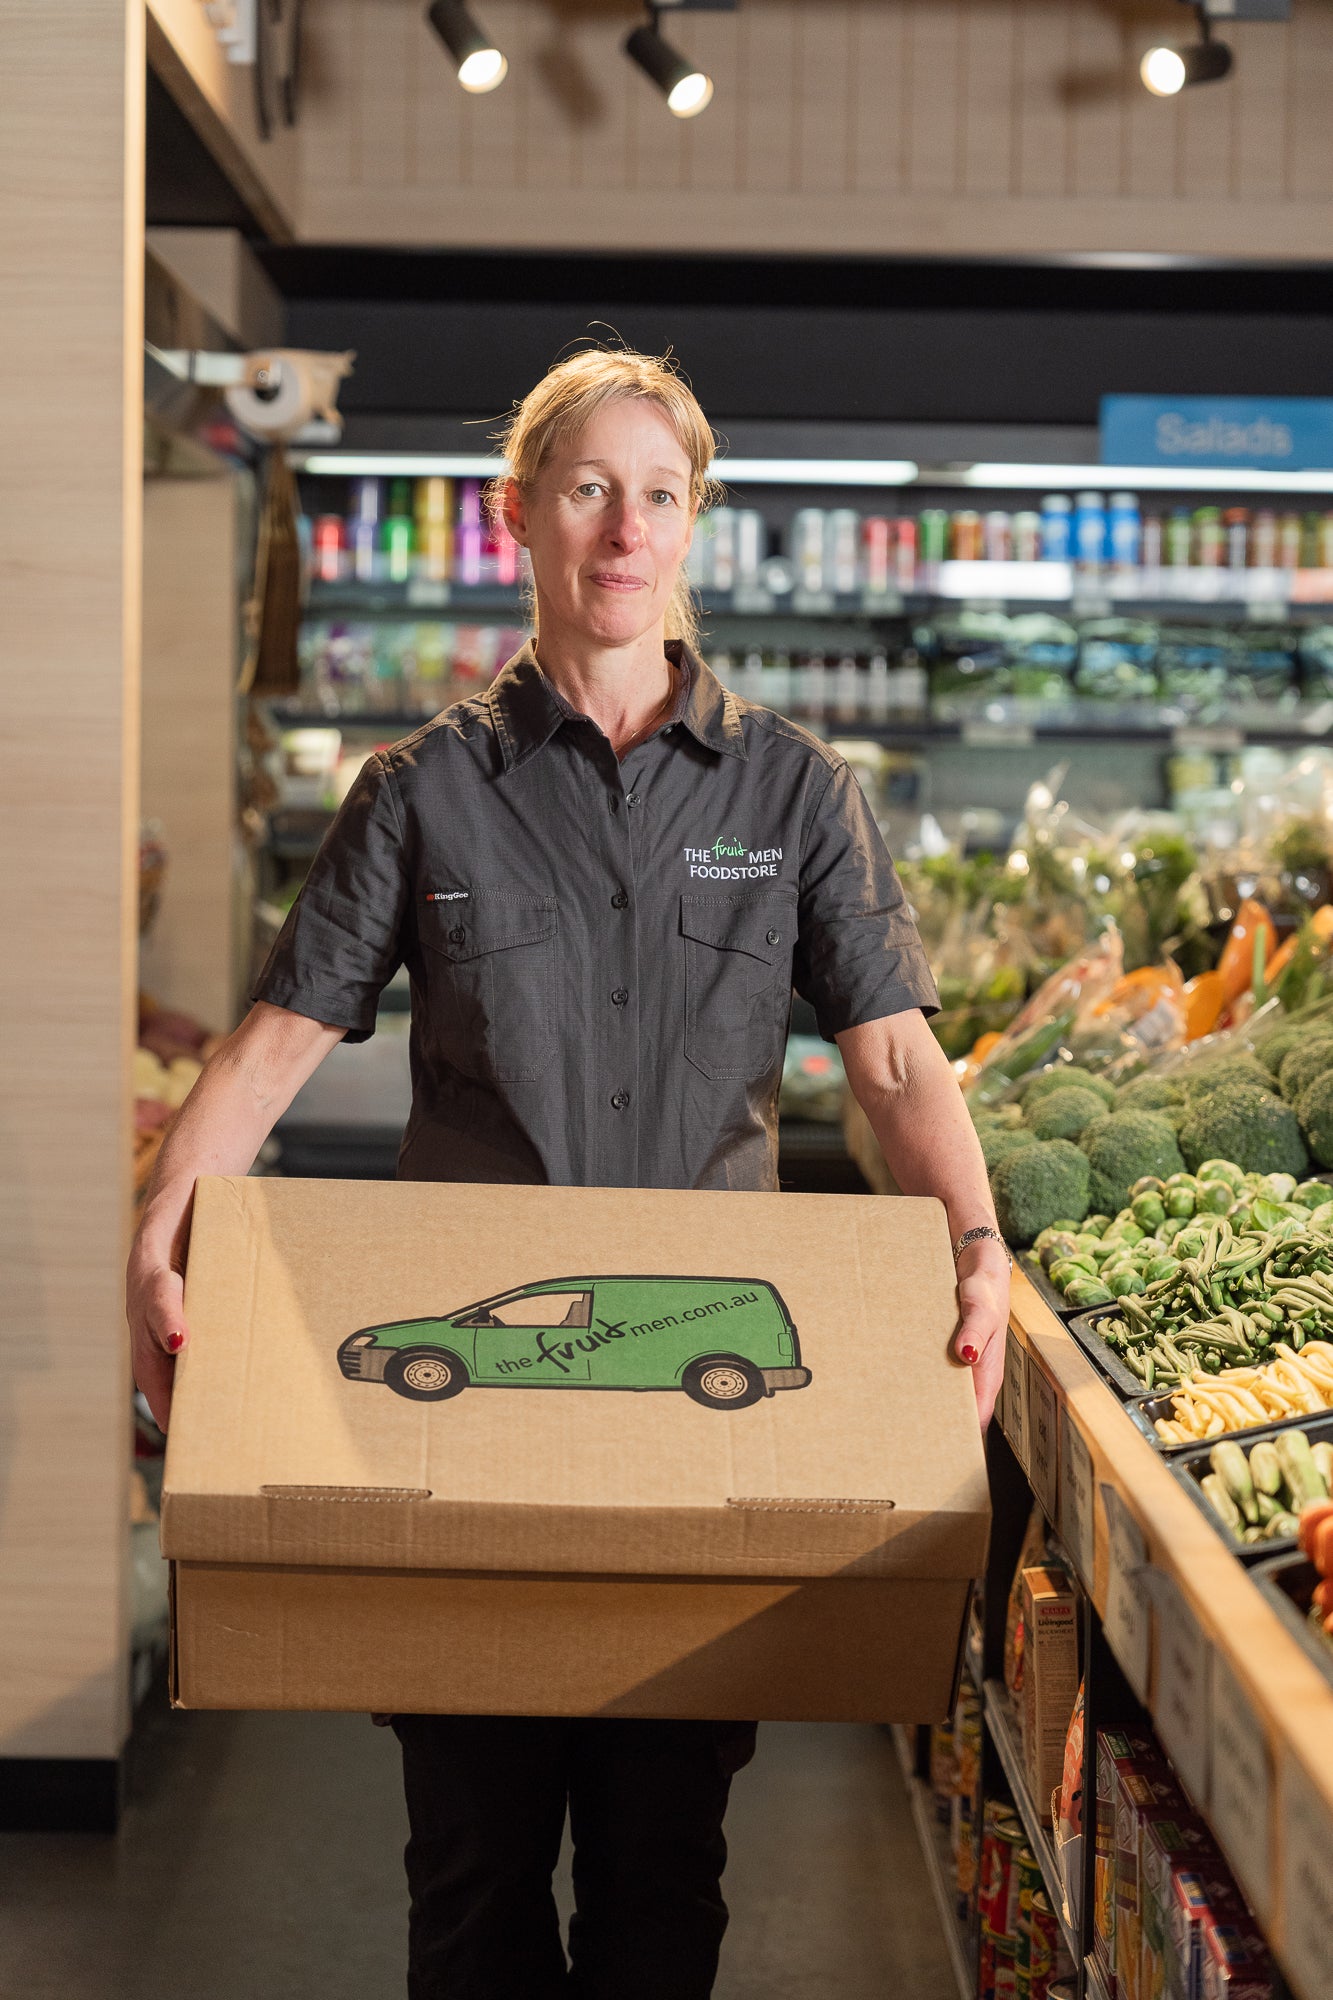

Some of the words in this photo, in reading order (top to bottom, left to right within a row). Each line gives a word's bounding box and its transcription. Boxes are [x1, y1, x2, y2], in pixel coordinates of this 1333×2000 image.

[1156, 413, 1293, 456] Salads
[684, 848, 711, 863] THE
[711, 836, 748, 860] fruit
[749, 847, 783, 864] MEN
[690, 864, 778, 880] FOODSTORE
[434, 892, 469, 901] KingGee
[495, 1353, 533, 1375] the
[536, 1318, 628, 1374] fruit
[629, 1291, 759, 1338] men.com.au
